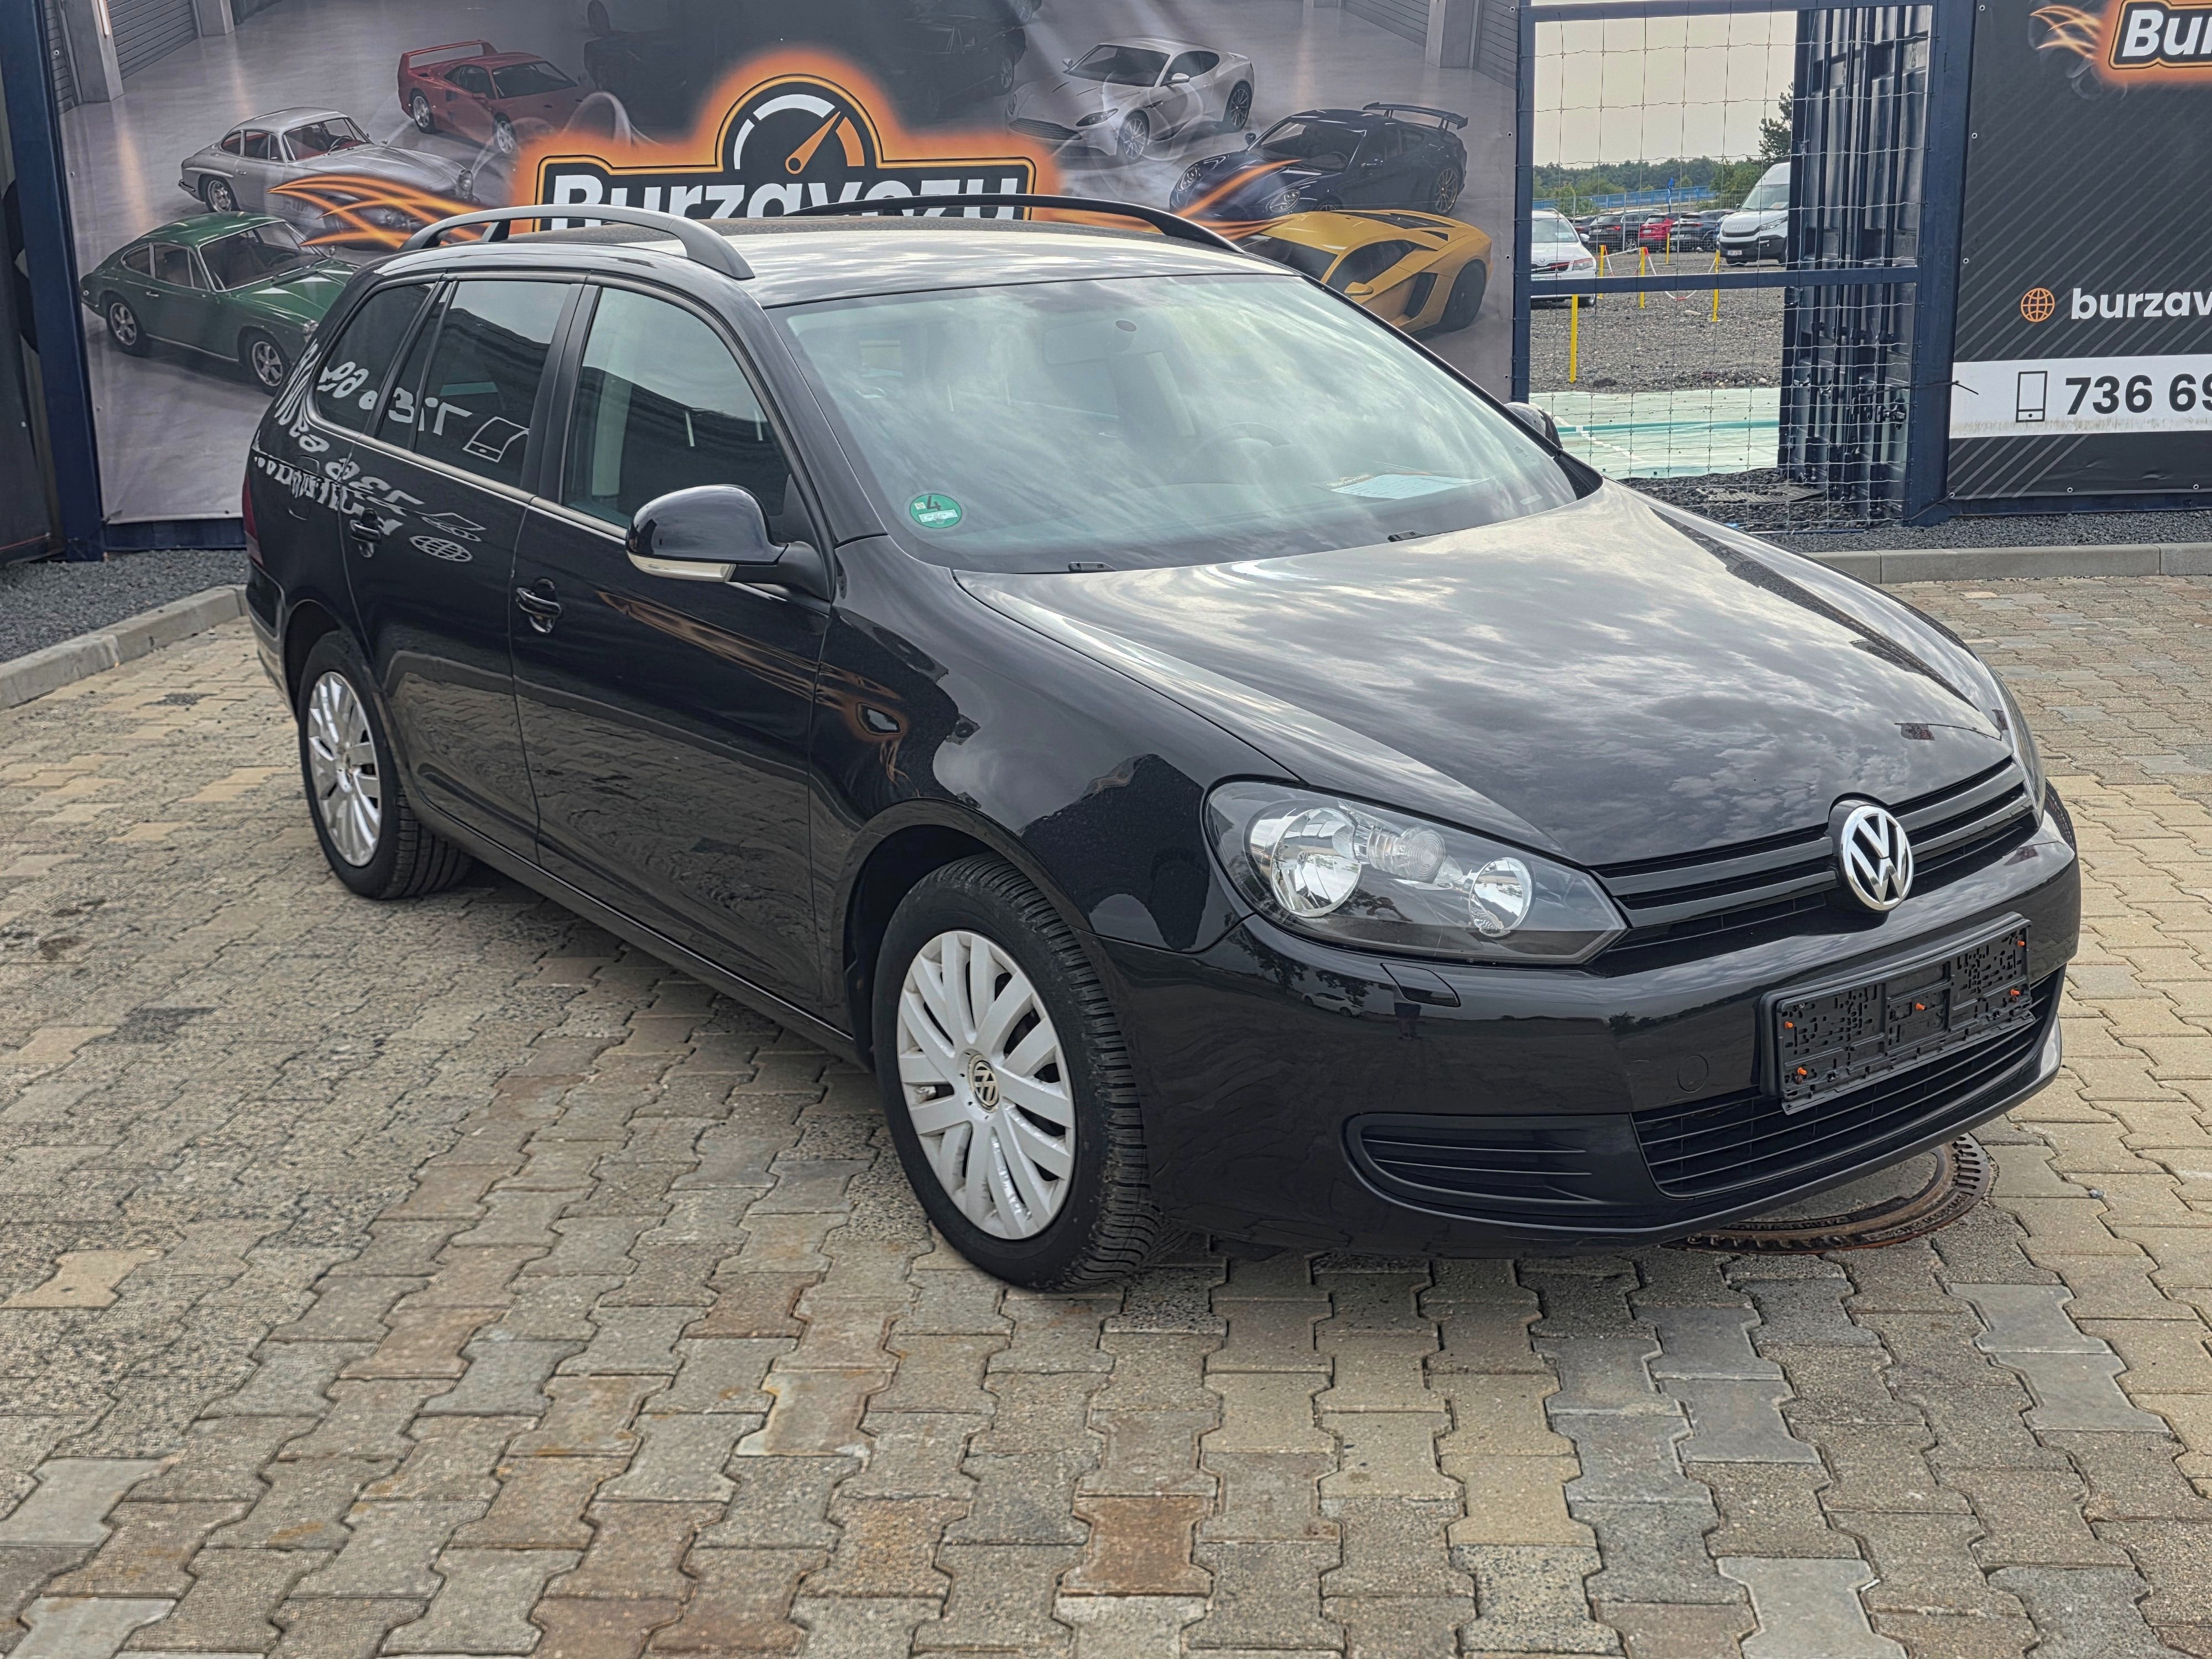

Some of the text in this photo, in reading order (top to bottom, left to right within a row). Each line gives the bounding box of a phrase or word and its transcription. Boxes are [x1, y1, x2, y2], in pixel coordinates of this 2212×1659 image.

[2071, 288, 2212, 320] burzav
[2065, 374, 2152, 415] 736
[927, 495, 941, 511] 4
[1842, 807, 1913, 910] VW
